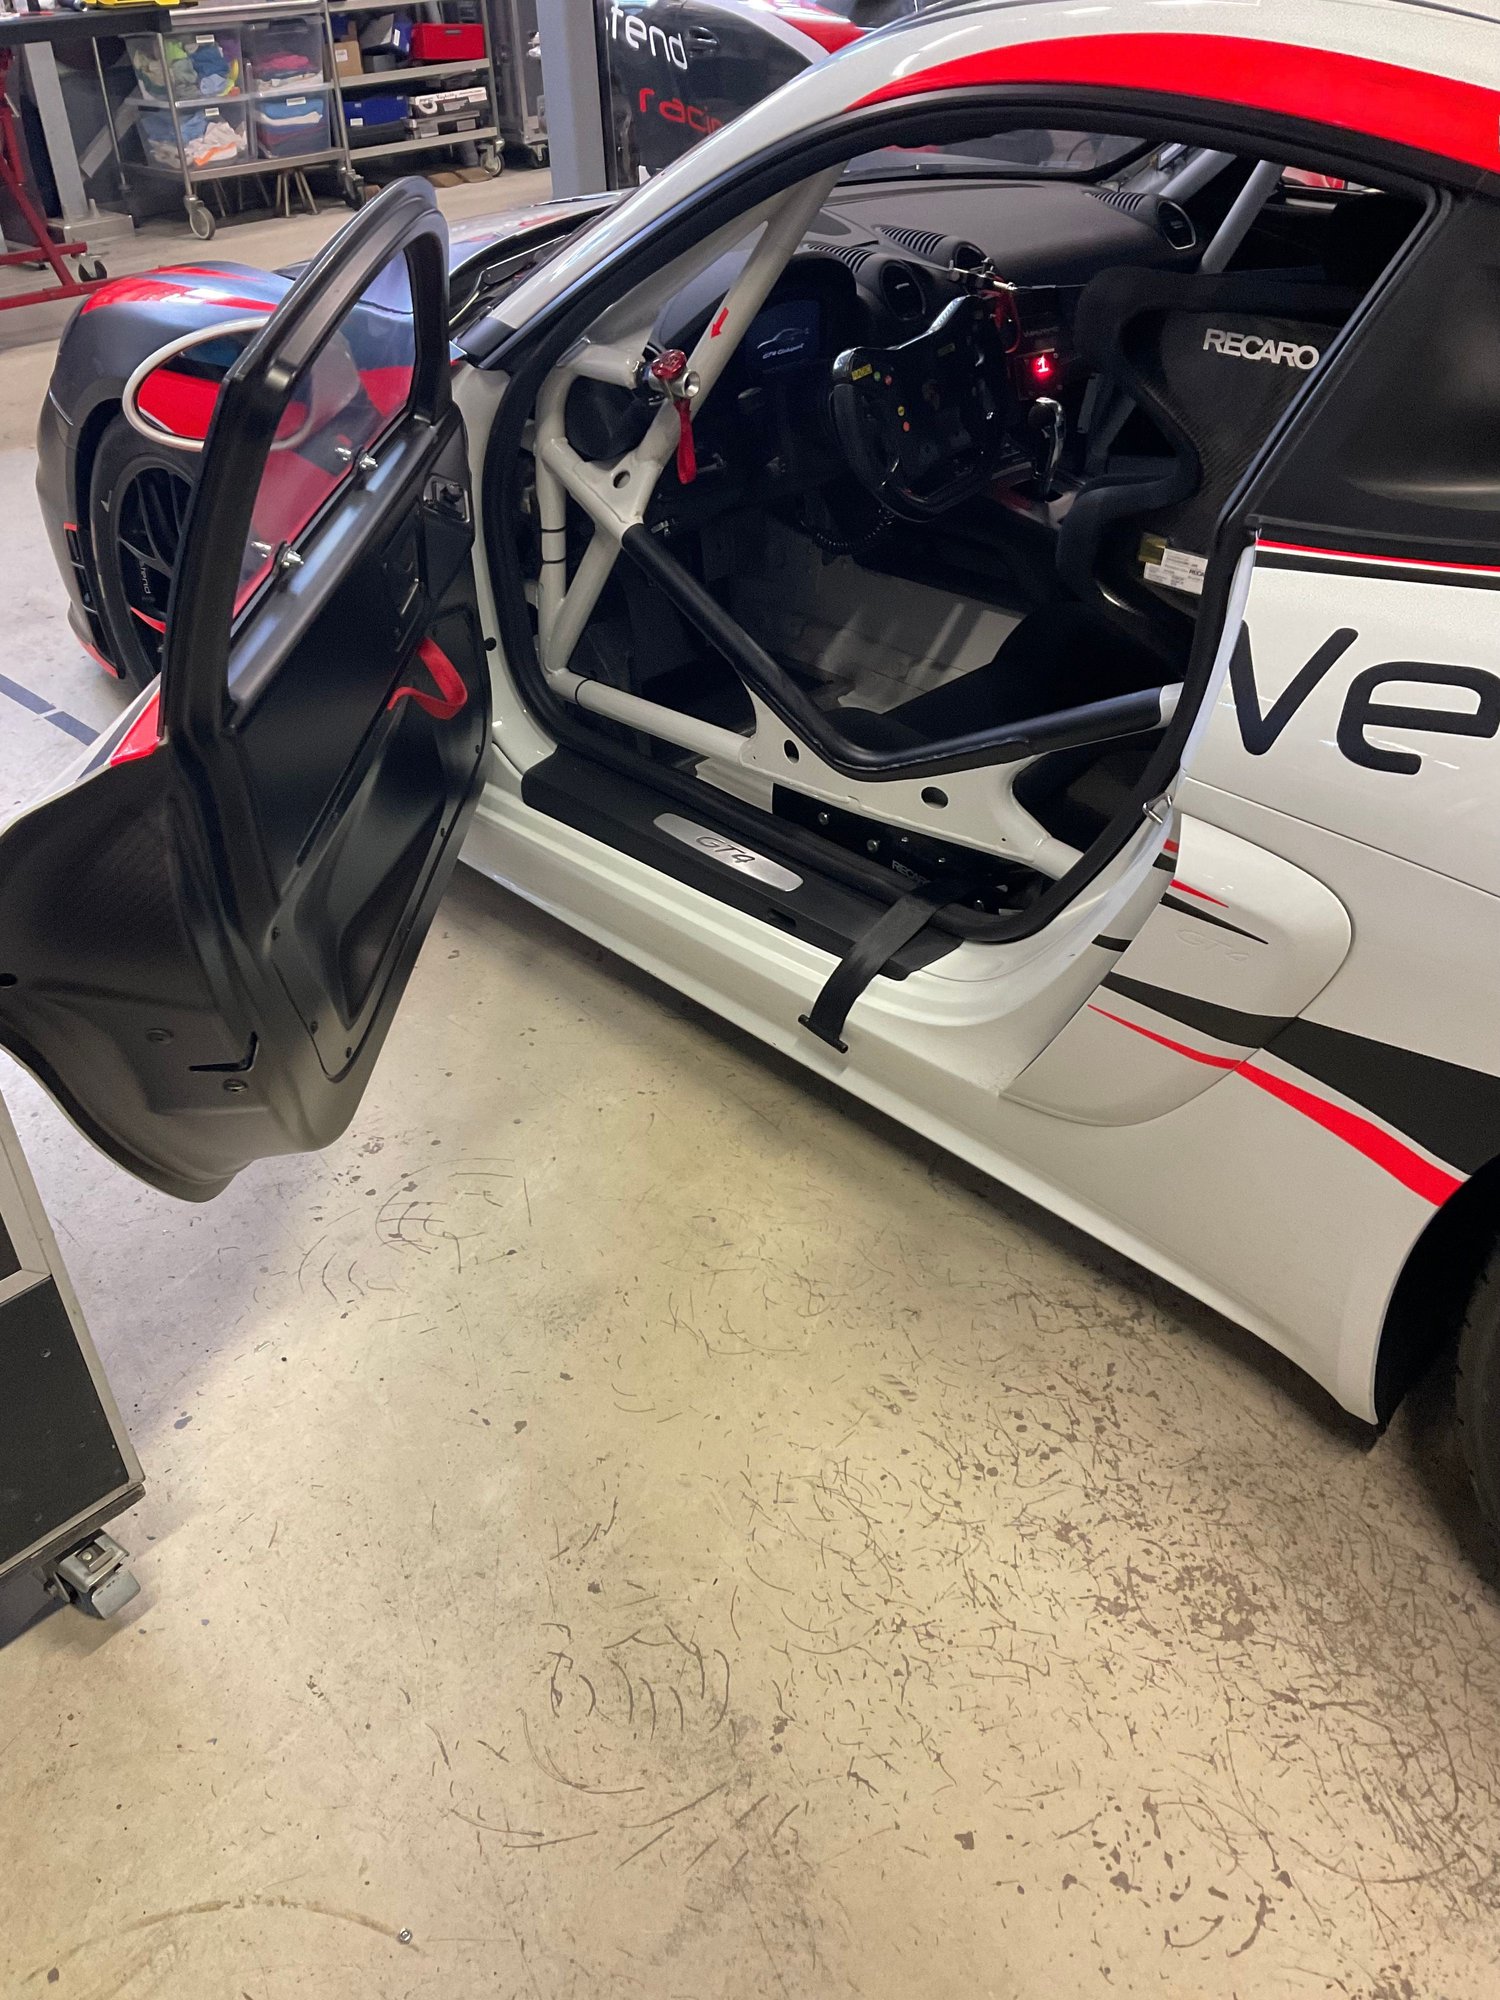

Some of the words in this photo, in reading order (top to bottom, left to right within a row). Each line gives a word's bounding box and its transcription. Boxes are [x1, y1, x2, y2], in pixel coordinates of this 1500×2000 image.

[1203, 328, 1320, 370] RECARO
[1037, 354, 1050, 373] 1
[695, 835, 756, 863] GT4
